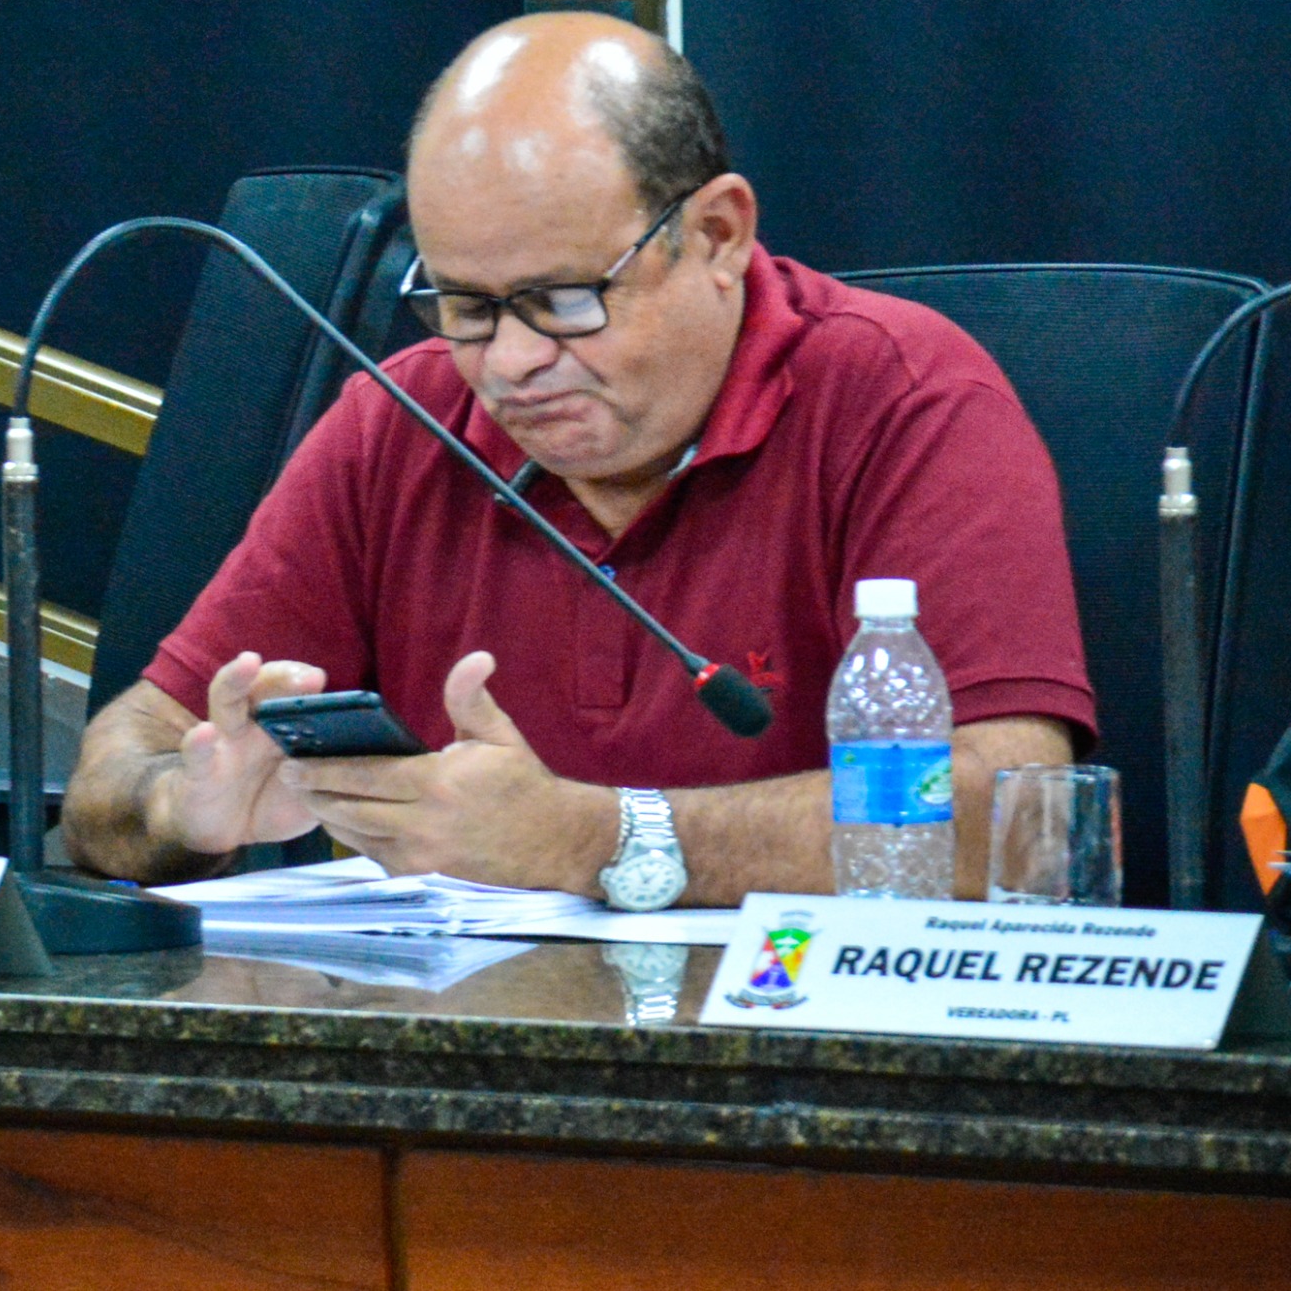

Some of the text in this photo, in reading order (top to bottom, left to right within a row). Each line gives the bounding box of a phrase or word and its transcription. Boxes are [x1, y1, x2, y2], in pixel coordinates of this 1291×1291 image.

[925, 916, 1157, 939] Raquel Aparecida Rezende
[831, 946, 1225, 993] RAQUEL REZENDE
[947, 1007, 1039, 1021] VEREADORA
[1051, 1011, 1070, 1024] PL
